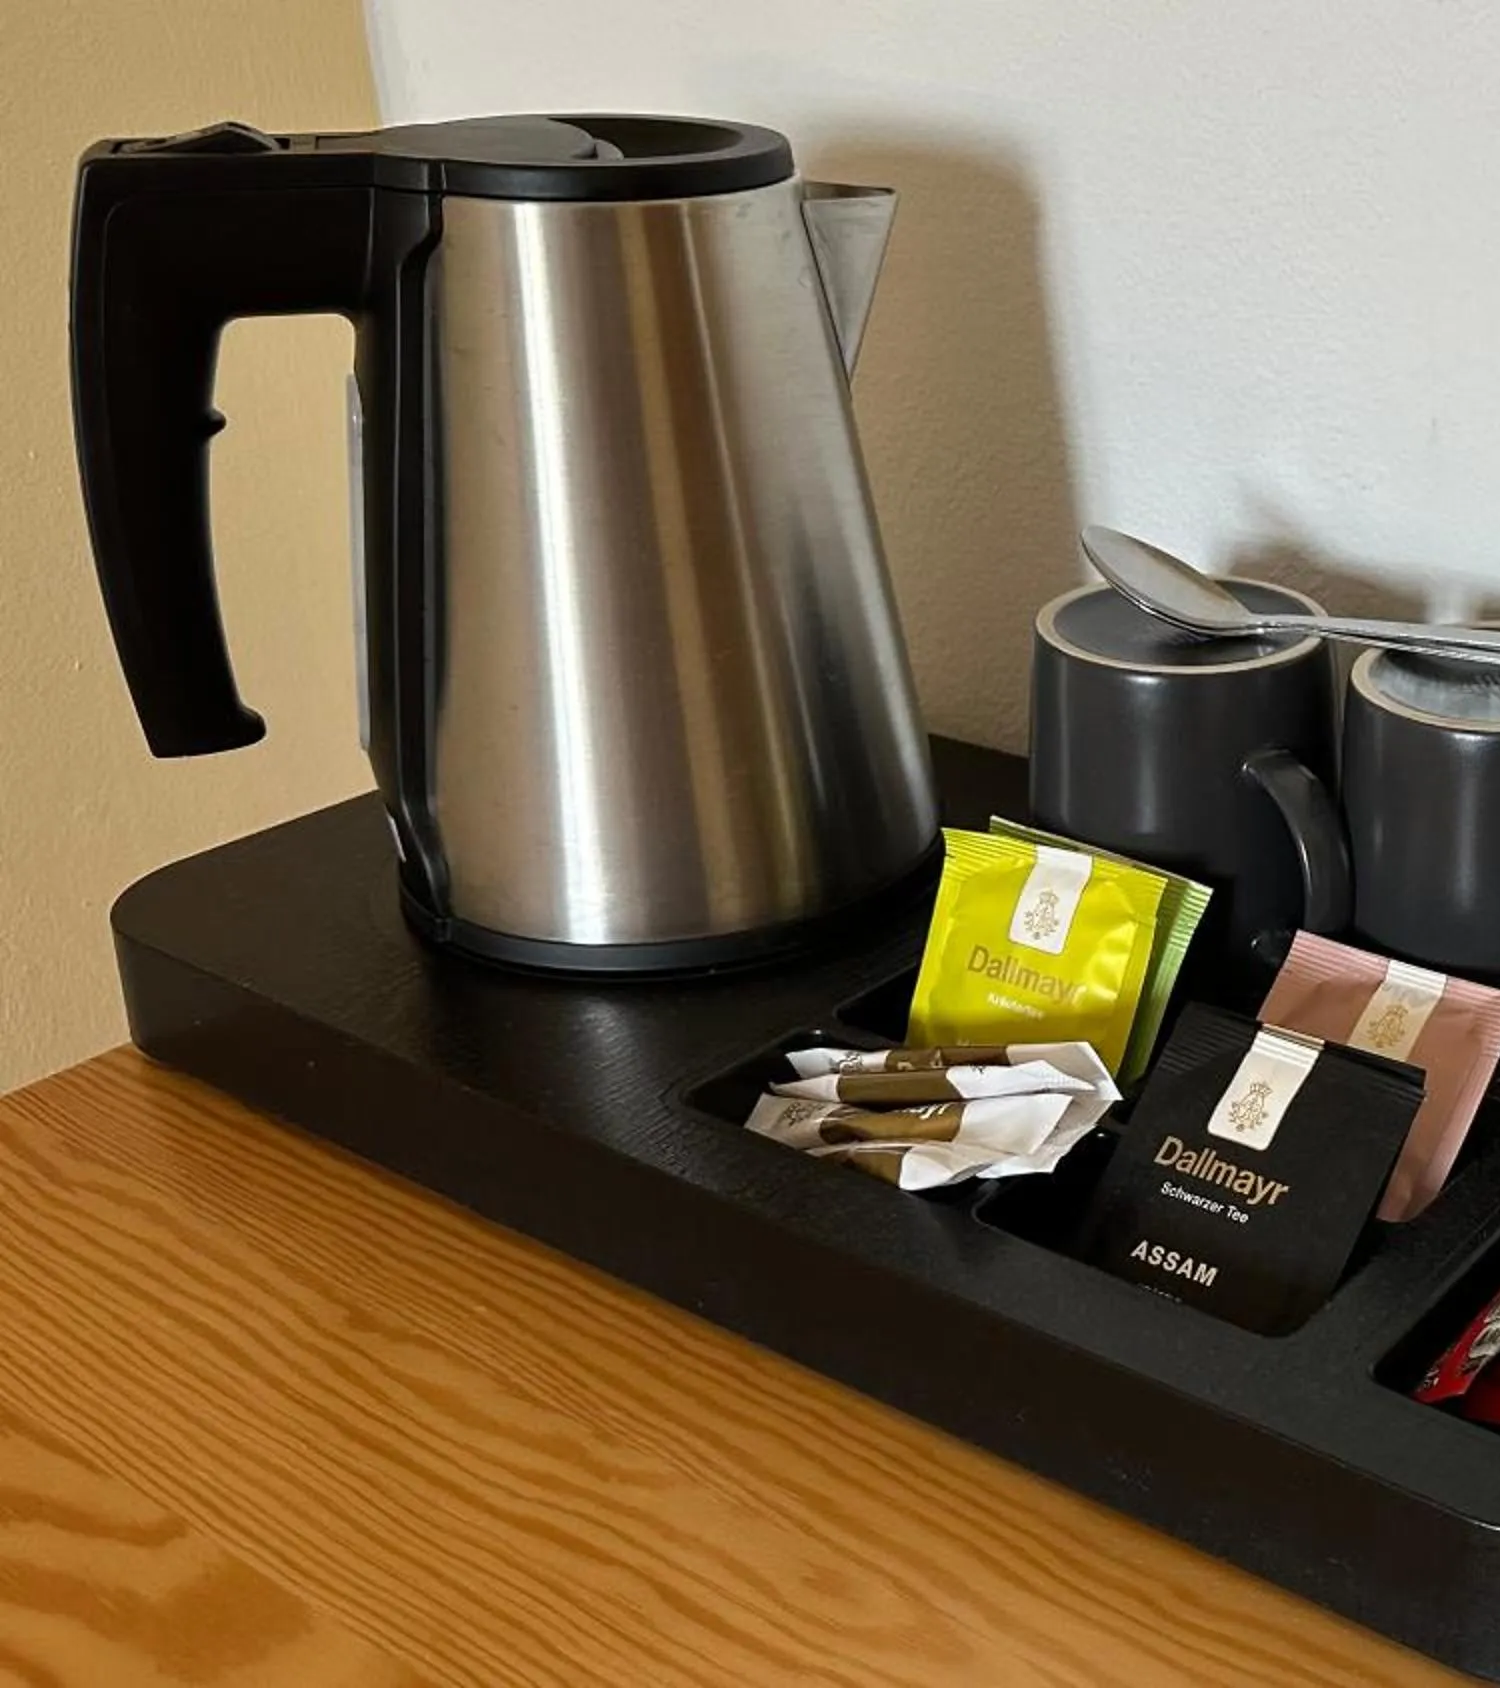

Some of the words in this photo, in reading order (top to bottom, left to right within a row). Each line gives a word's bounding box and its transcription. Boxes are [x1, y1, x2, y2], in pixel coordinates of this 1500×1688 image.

[967, 944, 1087, 1009] Dallmayr
[1153, 1135, 1290, 1205] Dallmayr
[1160, 1181, 1224, 1213] Schwarzer
[1226, 1205, 1249, 1223] Tee
[1130, 1240, 1219, 1287] ASSAM
